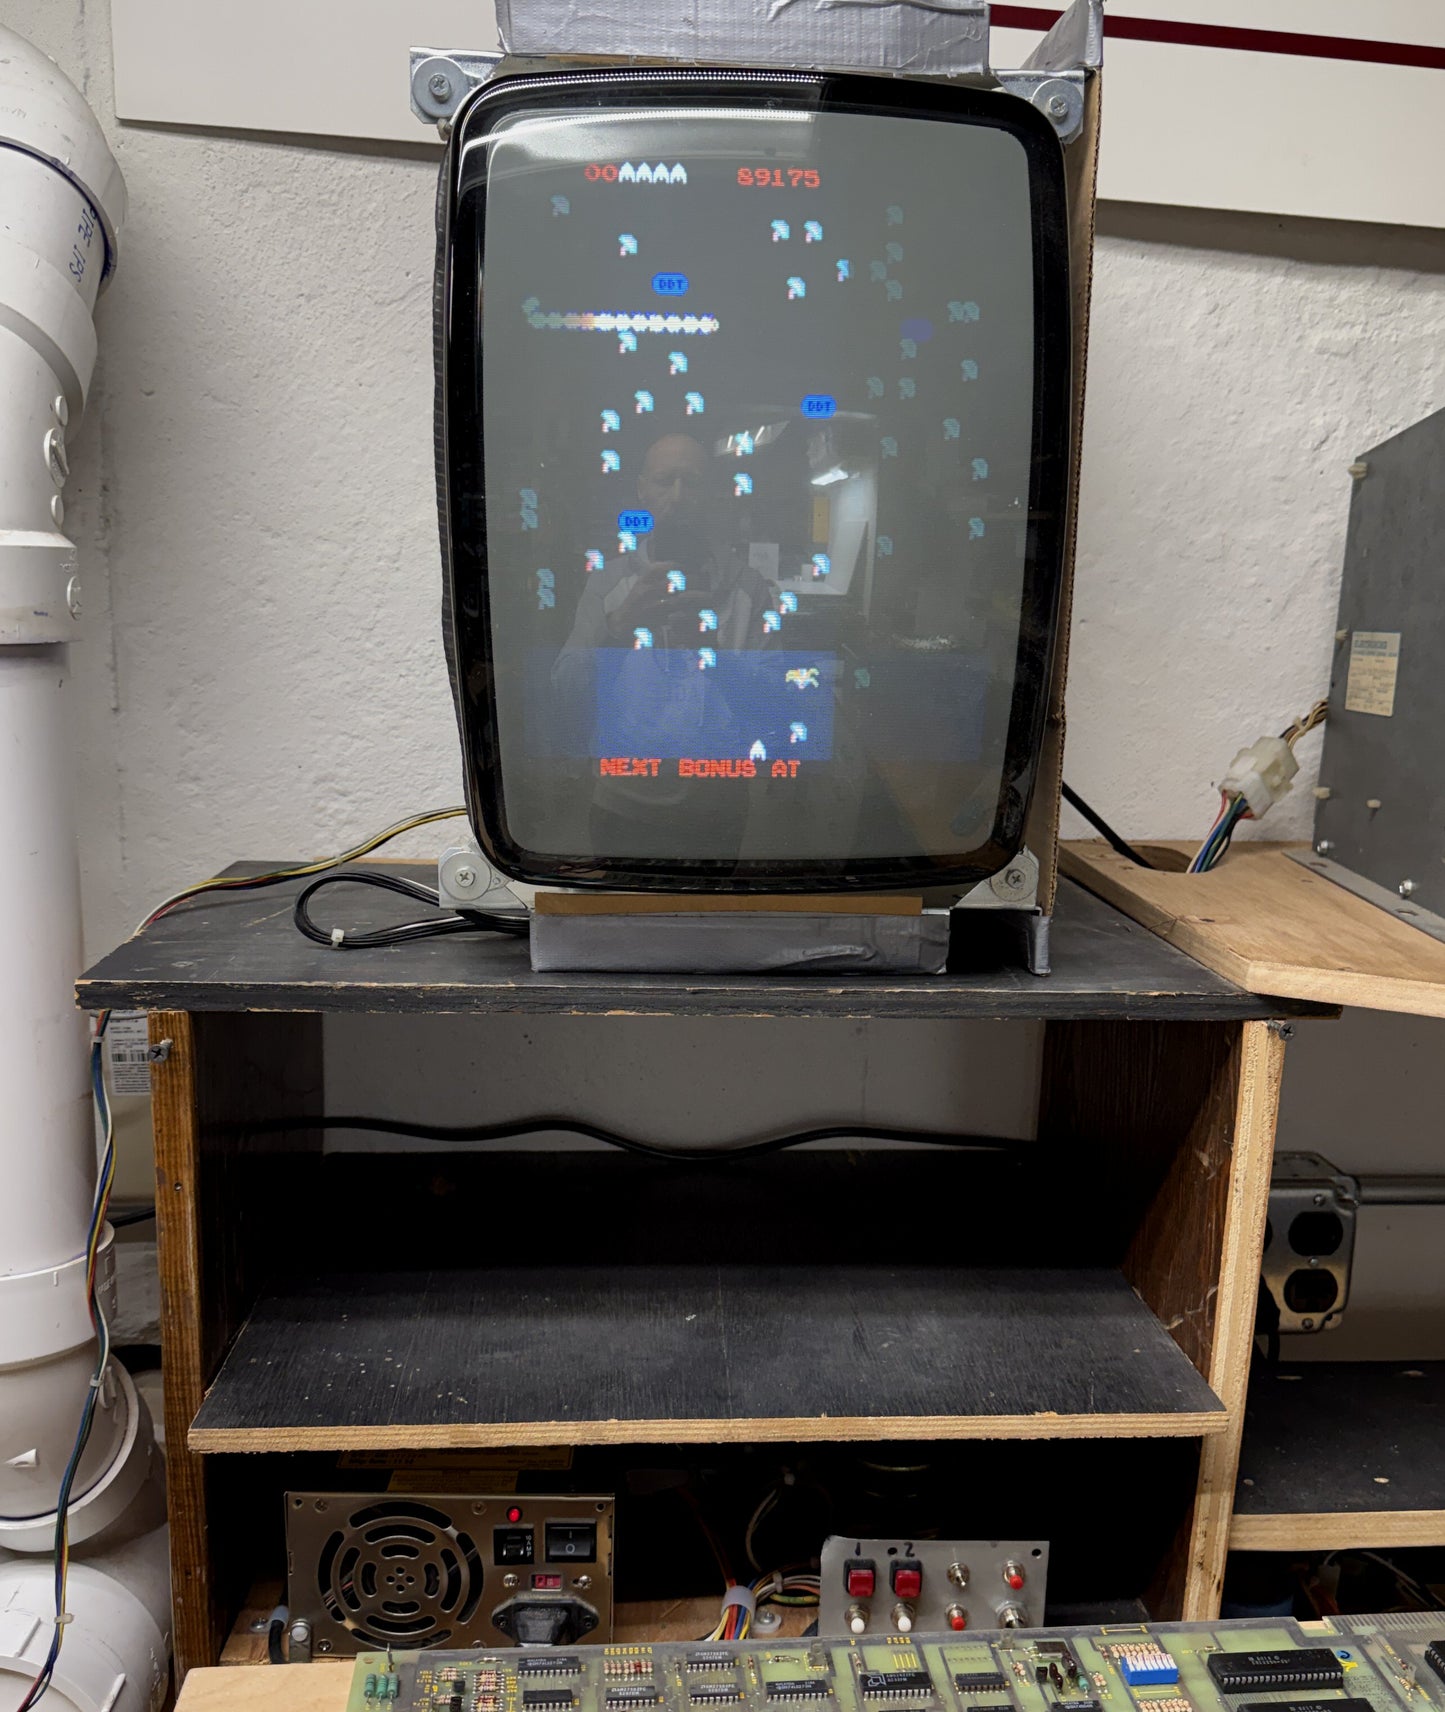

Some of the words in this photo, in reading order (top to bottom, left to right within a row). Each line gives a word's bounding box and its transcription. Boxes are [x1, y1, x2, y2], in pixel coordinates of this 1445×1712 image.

[737, 167, 820, 188] 89175
[657, 278, 684, 290] DDT
[807, 400, 833, 412] DDT
[624, 516, 650, 528] DDT
[600, 758, 662, 777] NEXT
[678, 758, 757, 778] BONUS
[771, 759, 801, 778] AT
[903, 1541, 915, 1558] 2
